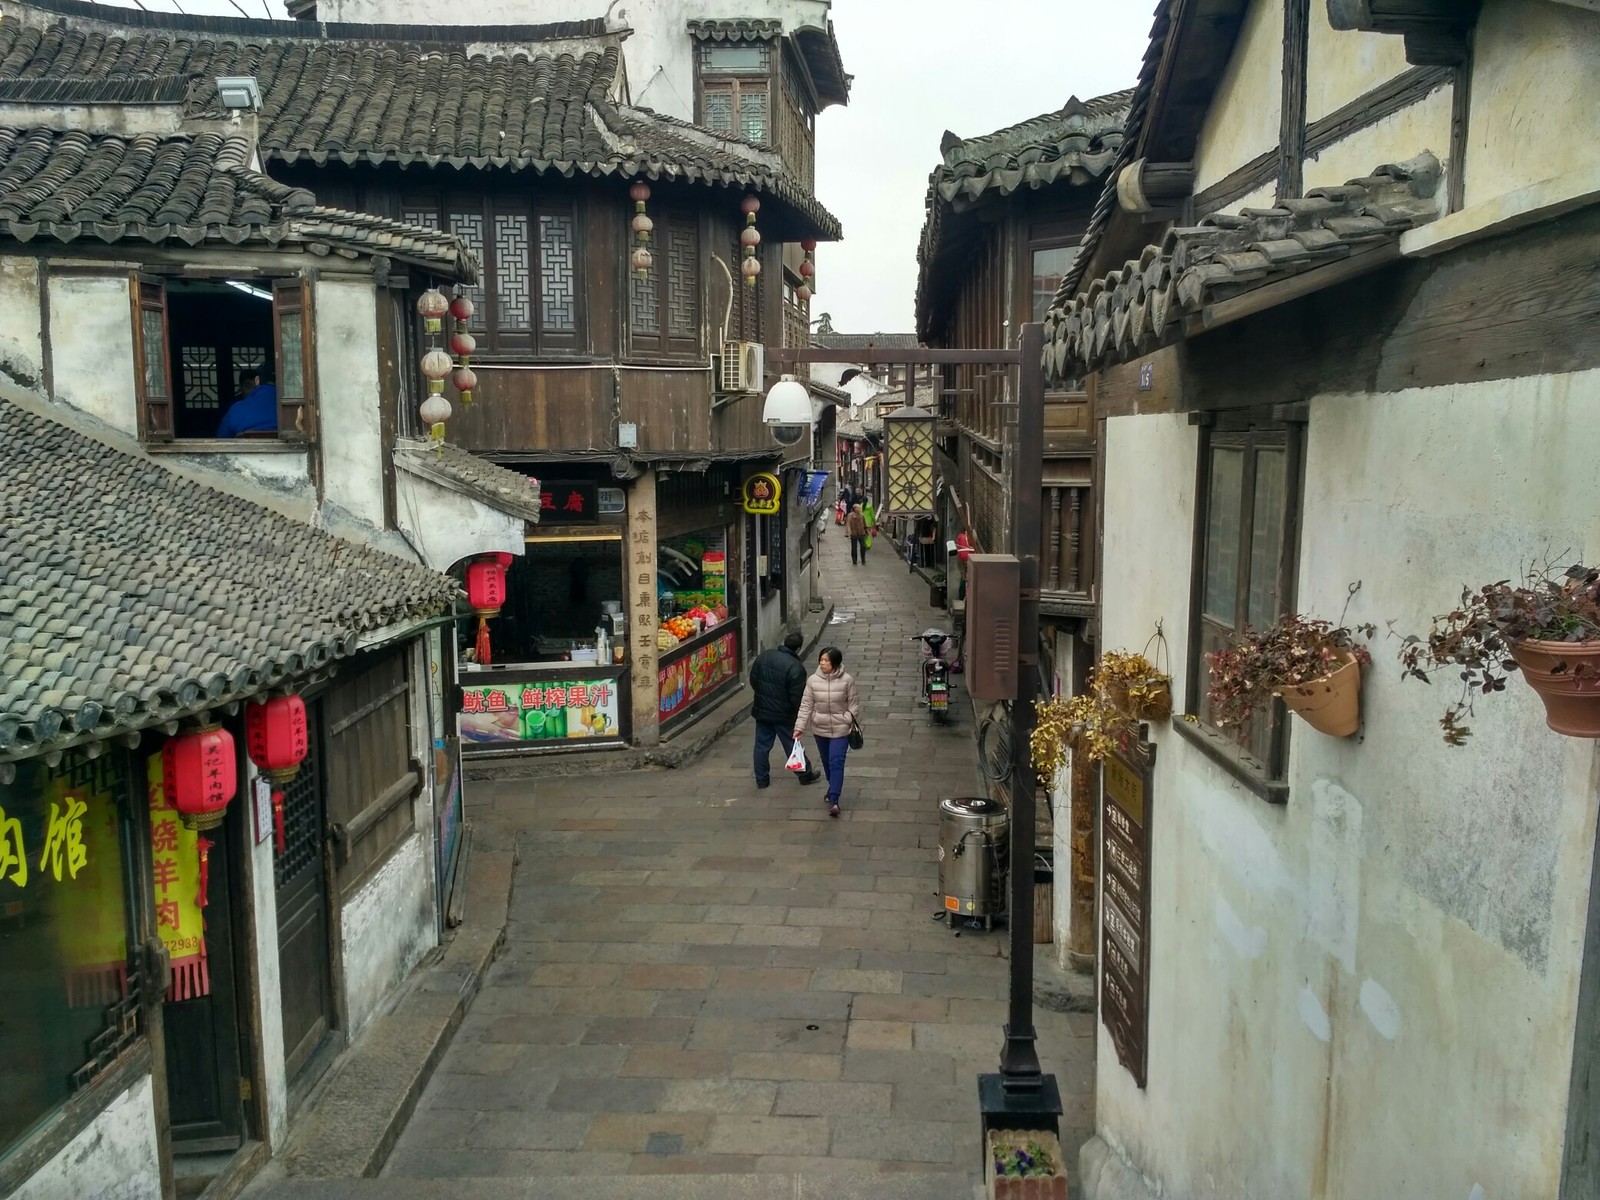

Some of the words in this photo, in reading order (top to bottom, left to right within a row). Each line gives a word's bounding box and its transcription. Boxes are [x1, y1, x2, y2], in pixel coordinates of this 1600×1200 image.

[463, 688, 509, 714] 鱿鱼
[521, 683, 612, 711] 鲜榨果汁
[149, 780, 180, 932] 红烧羊肉
